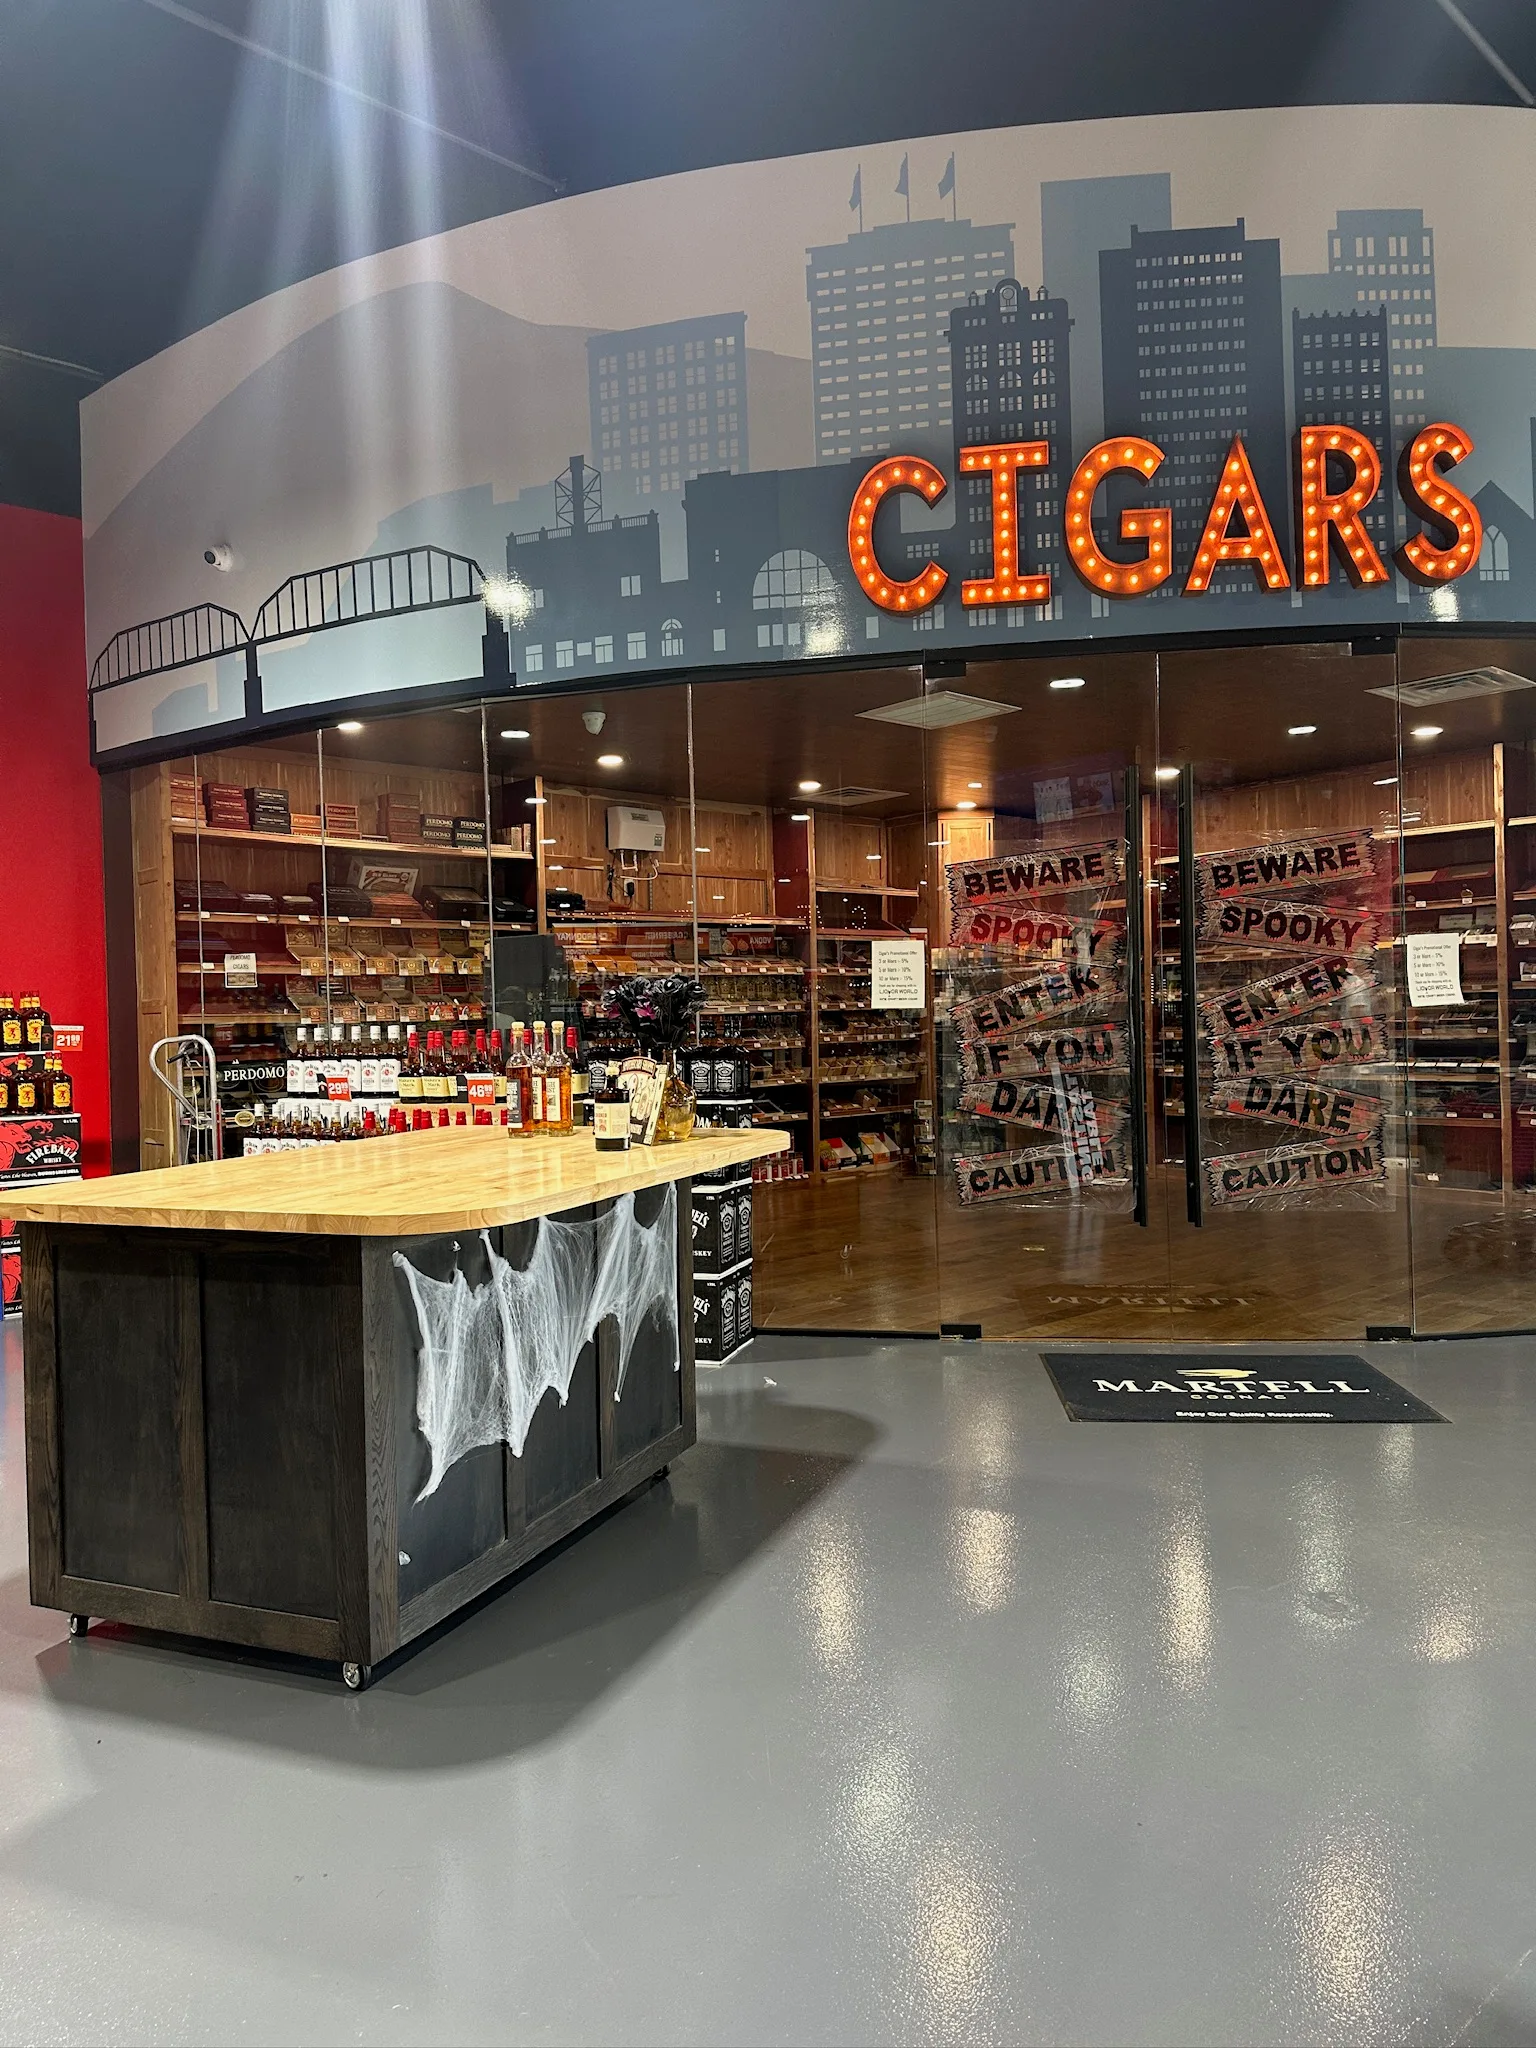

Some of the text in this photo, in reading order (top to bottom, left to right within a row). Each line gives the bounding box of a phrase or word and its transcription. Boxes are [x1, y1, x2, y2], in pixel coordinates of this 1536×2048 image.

[848, 421, 1483, 616] CIGARS
[426, 818, 452, 826] PERDOMO
[964, 853, 1106, 899] BEWARE
[1211, 841, 1362, 891] BEWARE
[1220, 906, 1364, 952] SPOOKY
[1222, 956, 1354, 1031] ENTER
[975, 1031, 1115, 1080] IF YOU
[1224, 1024, 1373, 1075] IF YOU
[224, 1066, 285, 1082] PERDOMO
[990, 1079, 1085, 1133] DAR
[1243, 1075, 1355, 1134] DARE
[25, 1144, 77, 1164] FIREBALL
[969, 1148, 1116, 1194] CAUTIN
[1222, 1146, 1375, 1194] CAUTION
[1092, 1379, 1370, 1394] MARTELL
